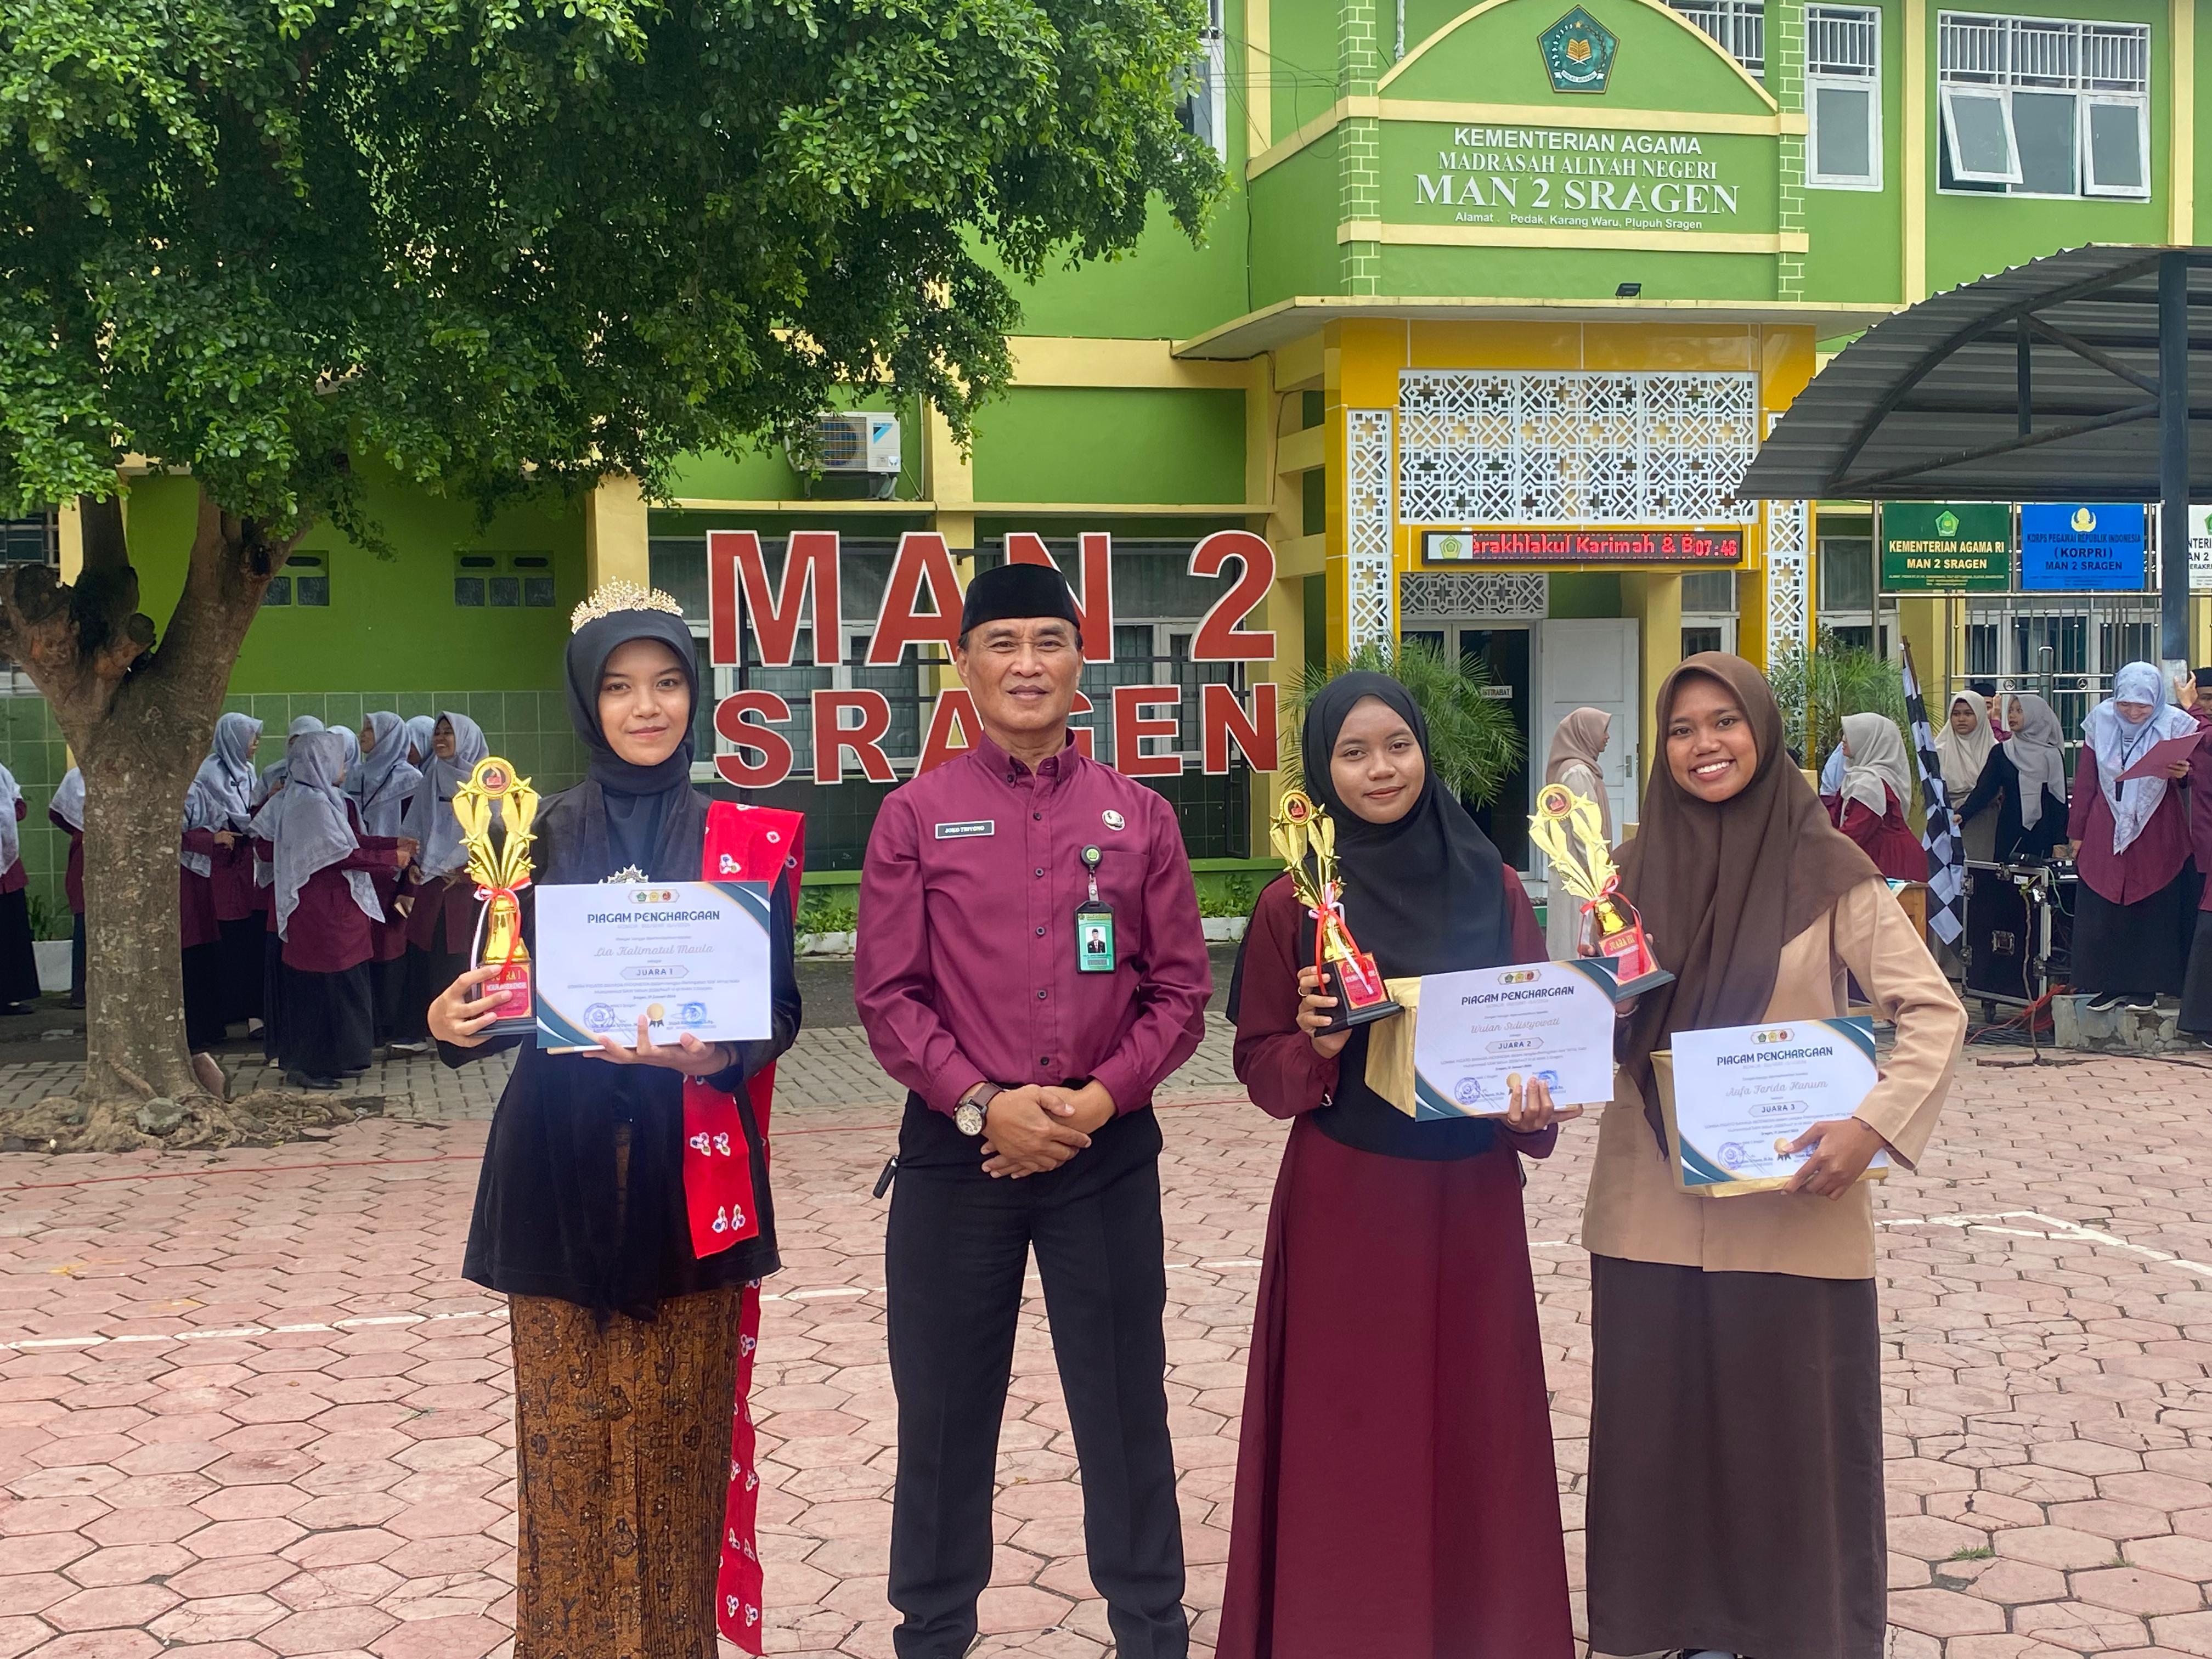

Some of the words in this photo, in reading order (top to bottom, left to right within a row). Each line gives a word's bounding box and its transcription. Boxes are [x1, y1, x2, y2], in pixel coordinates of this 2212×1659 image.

[1454, 127, 1615, 152] KEMENTERIAN
[1621, 135, 1702, 155] AGAMA
[1438, 151, 1556, 173] MADRASAH
[1560, 156, 1636, 176] ALIYAH
[1642, 159, 1717, 179] NEGERI
[1414, 174, 1519, 207] MAN
[1531, 178, 1550, 208] 2
[1565, 180, 1740, 215] SRAGEN
[1455, 212, 1493, 222] Alamat
[1550, 215, 1589, 228] Karang
[1626, 217, 1662, 230] Plupuh
[1665, 218, 1702, 231] Sragen
[1576, 534, 1655, 554] Karimah
[2027, 533, 2047, 543] KORPS
[2078, 534, 2107, 543] REPUBLIK
[2108, 534, 2141, 543] INDONESIA
[1889, 540, 1957, 552] KEMENTERIAN
[1959, 541, 1993, 553] AGAMA
[1995, 541, 2004, 553] RI
[2203, 552, 2209, 561] 2
[1906, 558, 1931, 569] MAN
[1934, 558, 1941, 568] 2
[1944, 558, 1987, 569] SRAGEN
[2045, 561, 2068, 571] MAN
[2072, 561, 2078, 571] 2
[2081, 561, 2123, 571] SRAGEN
[706, 529, 1114, 668] MAN
[1187, 530, 1277, 662] 2
[587, 912, 631, 923] PIAGAM
[634, 910, 720, 923] PENGHARGAAN
[636, 968, 667, 976] JUARA
[1462, 993, 1498, 1006] PIAGAM
[1501, 986, 1575, 1001] PENGHARGAAN
[1498, 1041, 1524, 1049] JUARA
[1717, 1053, 1754, 1066] PIAGAM
[1757, 1046, 1833, 1062] PENGHARGAAN
[1762, 1104, 1788, 1113] JUARA
